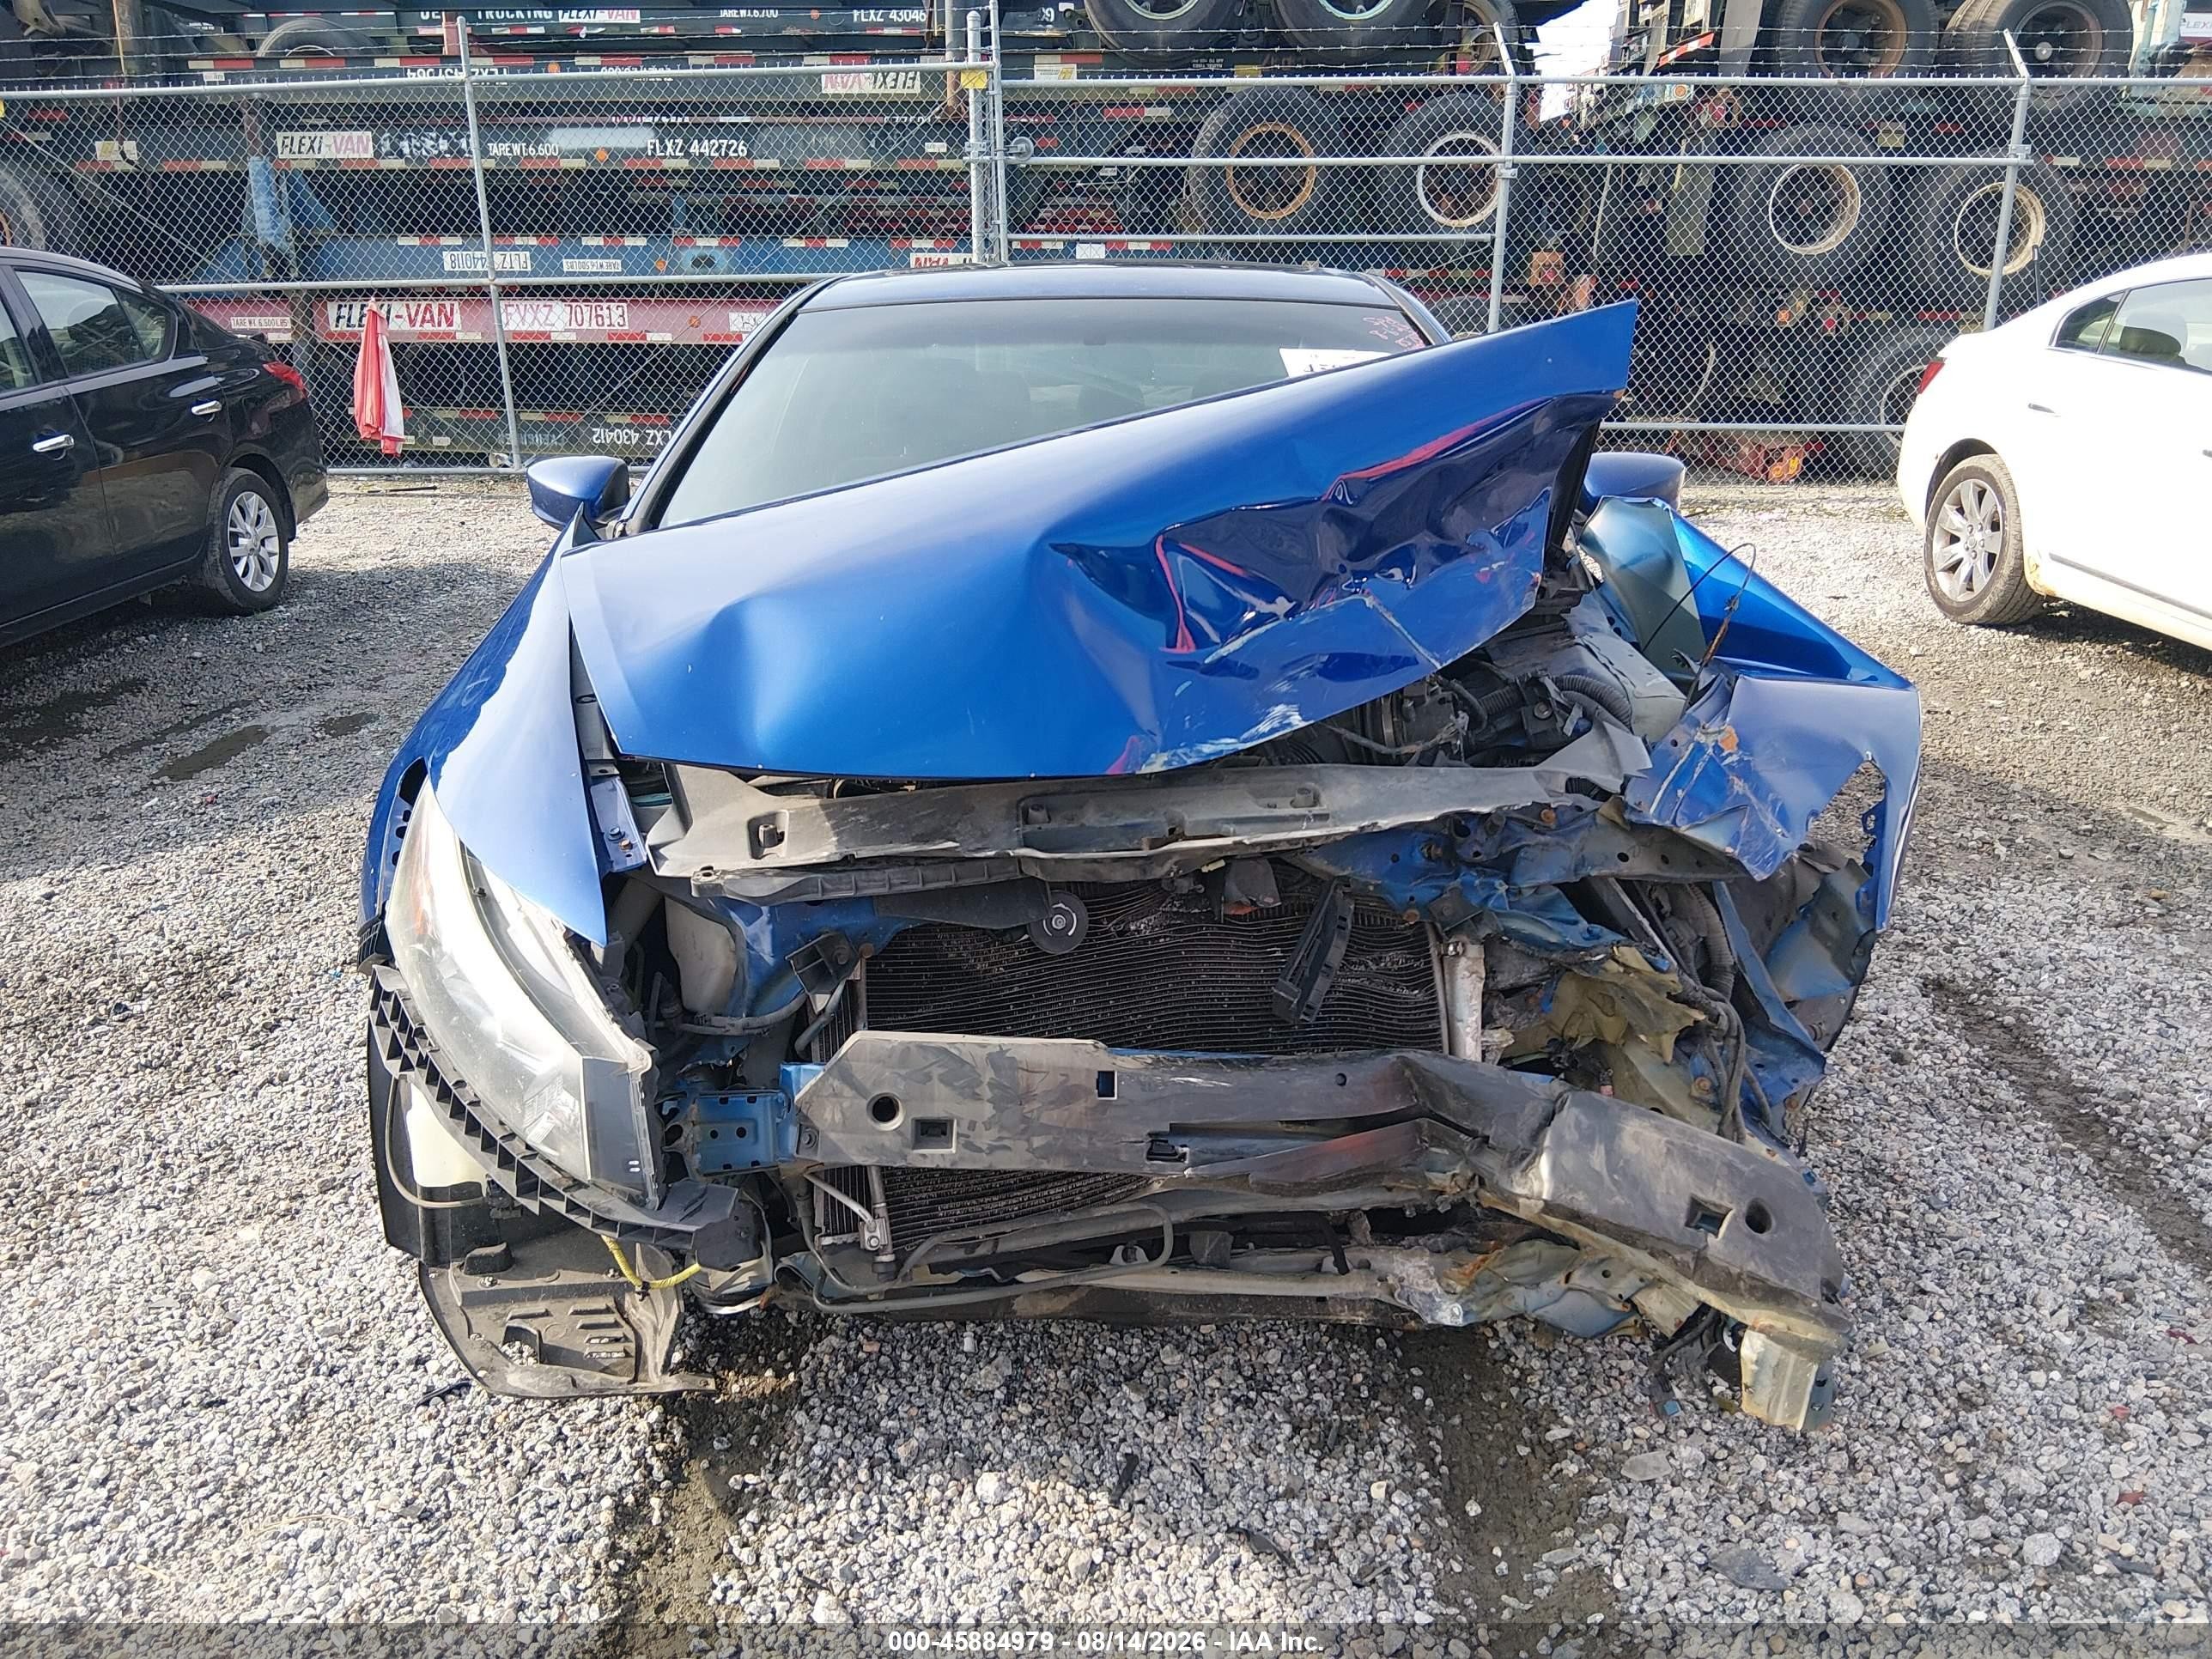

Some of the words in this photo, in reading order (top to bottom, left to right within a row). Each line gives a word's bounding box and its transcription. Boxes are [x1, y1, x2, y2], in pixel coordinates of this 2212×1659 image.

[647, 140, 684, 156] FLXZ
[690, 139, 747, 157] 442726
[564, 304, 626, 327] 707613
[592, 428, 639, 445] 430412
